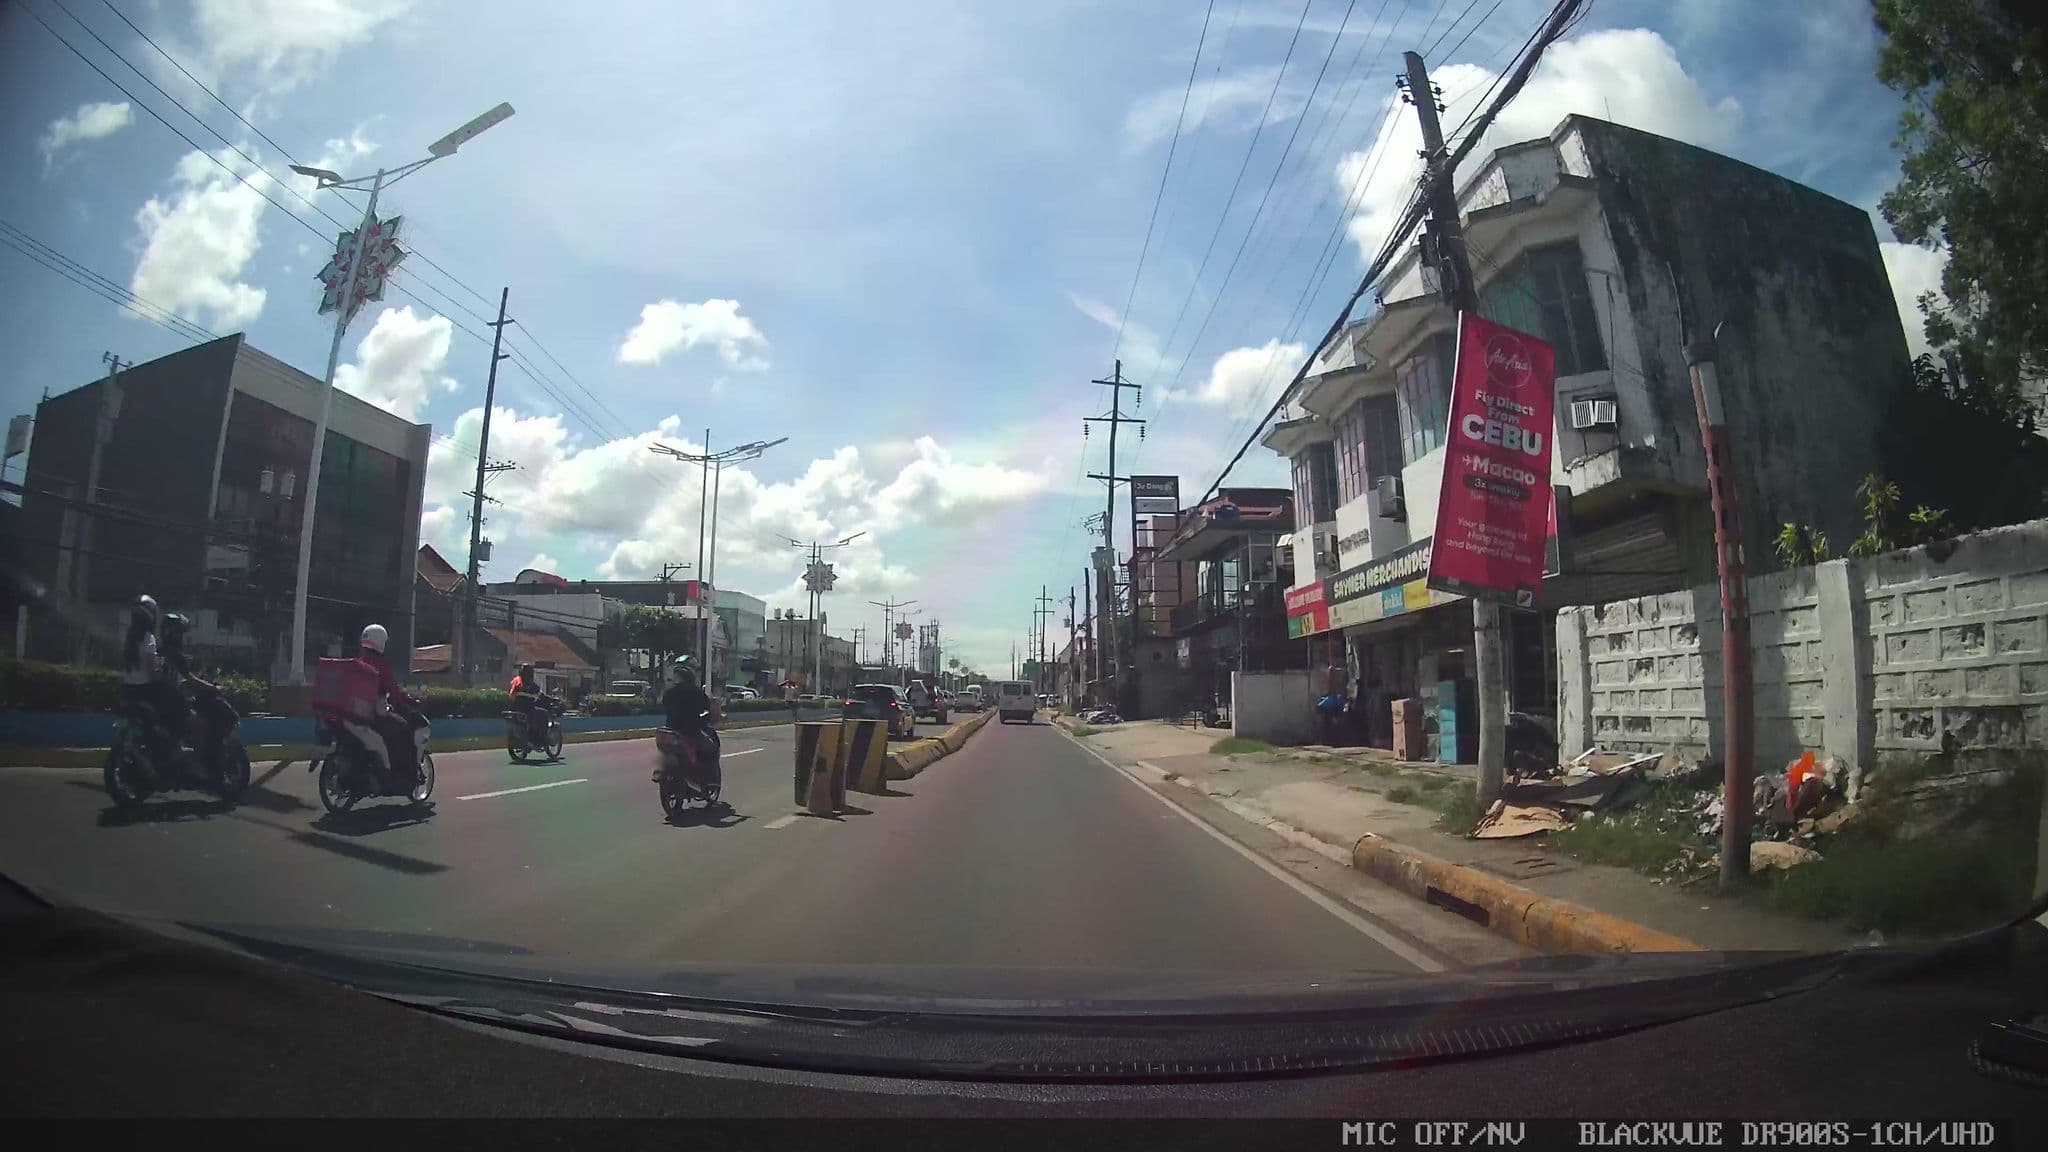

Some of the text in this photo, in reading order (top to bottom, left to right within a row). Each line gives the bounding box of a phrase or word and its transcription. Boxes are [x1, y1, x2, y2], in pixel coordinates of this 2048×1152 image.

[1475, 389, 1535, 416] Fly Direct
[1488, 409, 1519, 425] From
[1462, 414, 1542, 456] CEBU
[1472, 453, 1536, 486] Macao
[1474, 477, 1487, 489] 3x
[1457, 515, 1478, 528] Your
[1446, 538, 1465, 550] and
